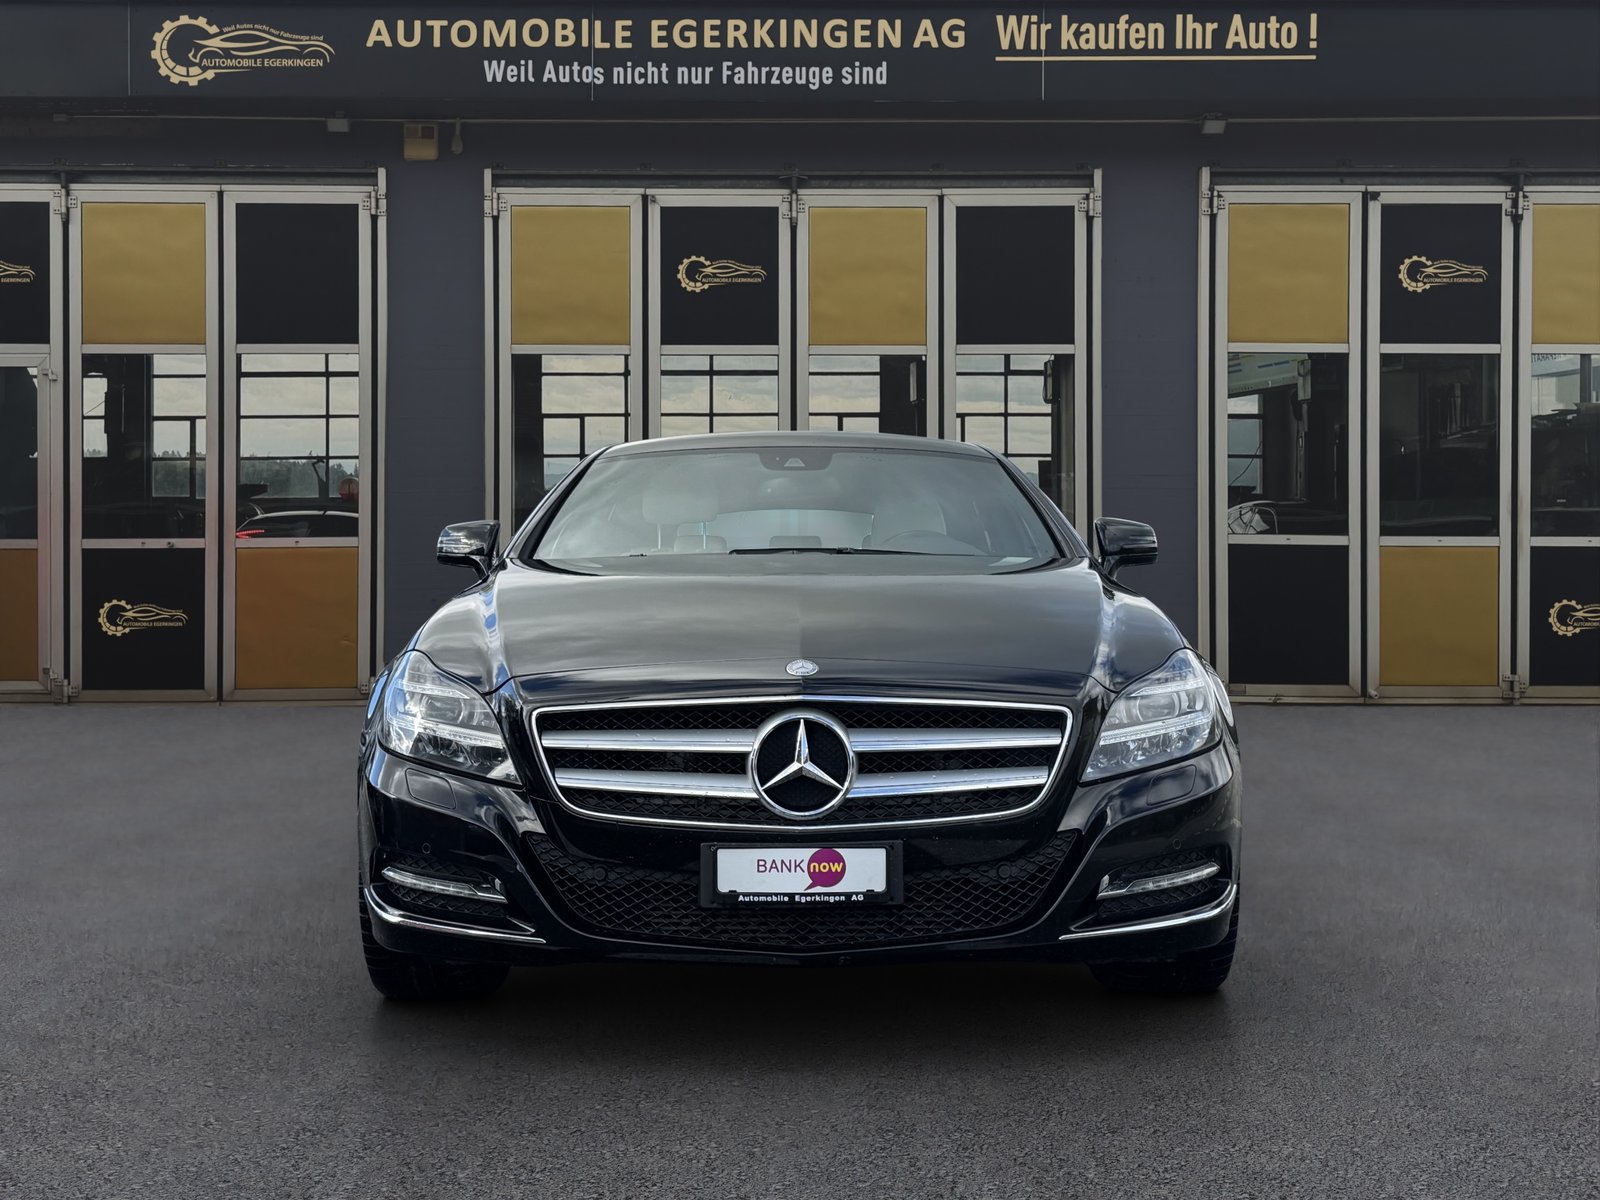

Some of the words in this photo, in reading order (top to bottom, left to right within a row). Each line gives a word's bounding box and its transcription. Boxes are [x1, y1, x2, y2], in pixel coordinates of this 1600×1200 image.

[365, 18, 632, 49] AUTOMOBILE
[650, 18, 902, 49] EGERKINGEN
[912, 18, 966, 49] AG
[996, 14, 1052, 51] Wir
[1060, 13, 1165, 50] kaufen
[1175, 13, 1219, 50] Ihr
[1225, 13, 1298, 50] Auto
[1309, 12, 1318, 49] !
[201, 58, 263, 67] AUTOMOBILE
[264, 58, 324, 67] EGERKINGEN
[483, 59, 535, 83] Weil
[542, 60, 605, 85] Autos
[612, 61, 669, 85] nicht
[677, 66, 714, 85] nur
[722, 61, 833, 90] Fahrzeuge
[841, 61, 887, 85] sind
[757, 859, 805, 873] BANK
[810, 862, 843, 872] now
[738, 894, 789, 902] Automobile
[794, 894, 846, 903] Egerkingen
